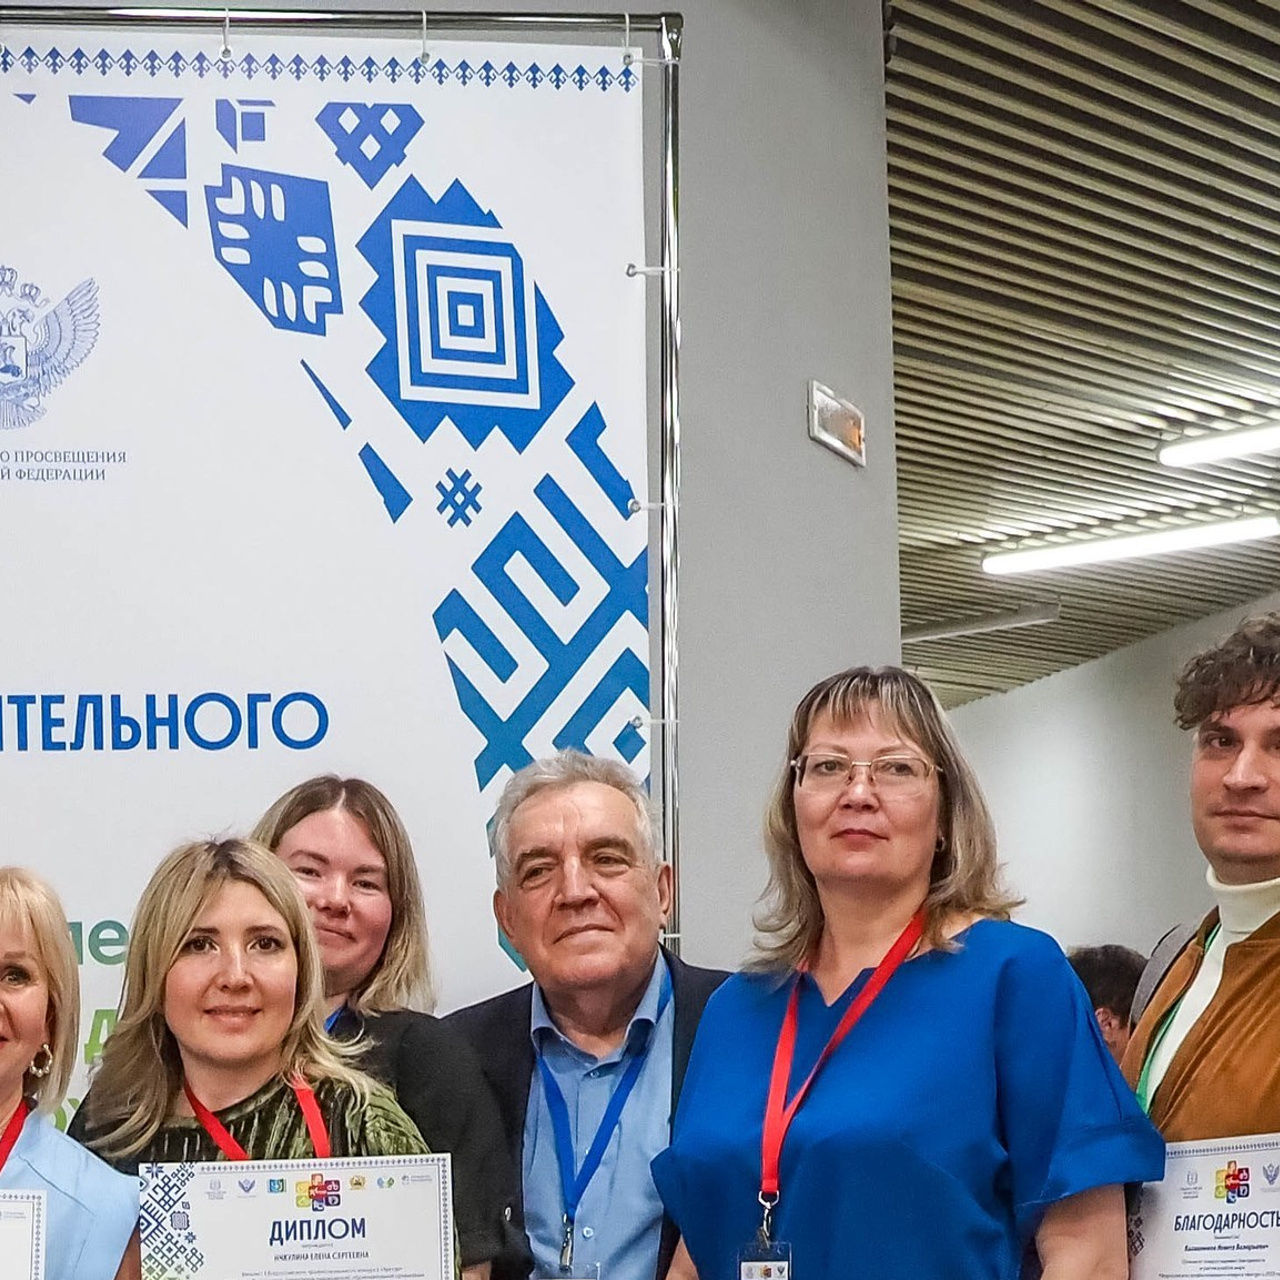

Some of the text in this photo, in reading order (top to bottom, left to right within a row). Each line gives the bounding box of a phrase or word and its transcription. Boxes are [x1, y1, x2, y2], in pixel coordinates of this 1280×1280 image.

[14, 451, 127, 465] ПРОСВЕЩЕНИЯ
[15, 468, 106, 482] ФЕДЕРАЦИИ
[269, 1217, 366, 1246] ДИПЛОМ
